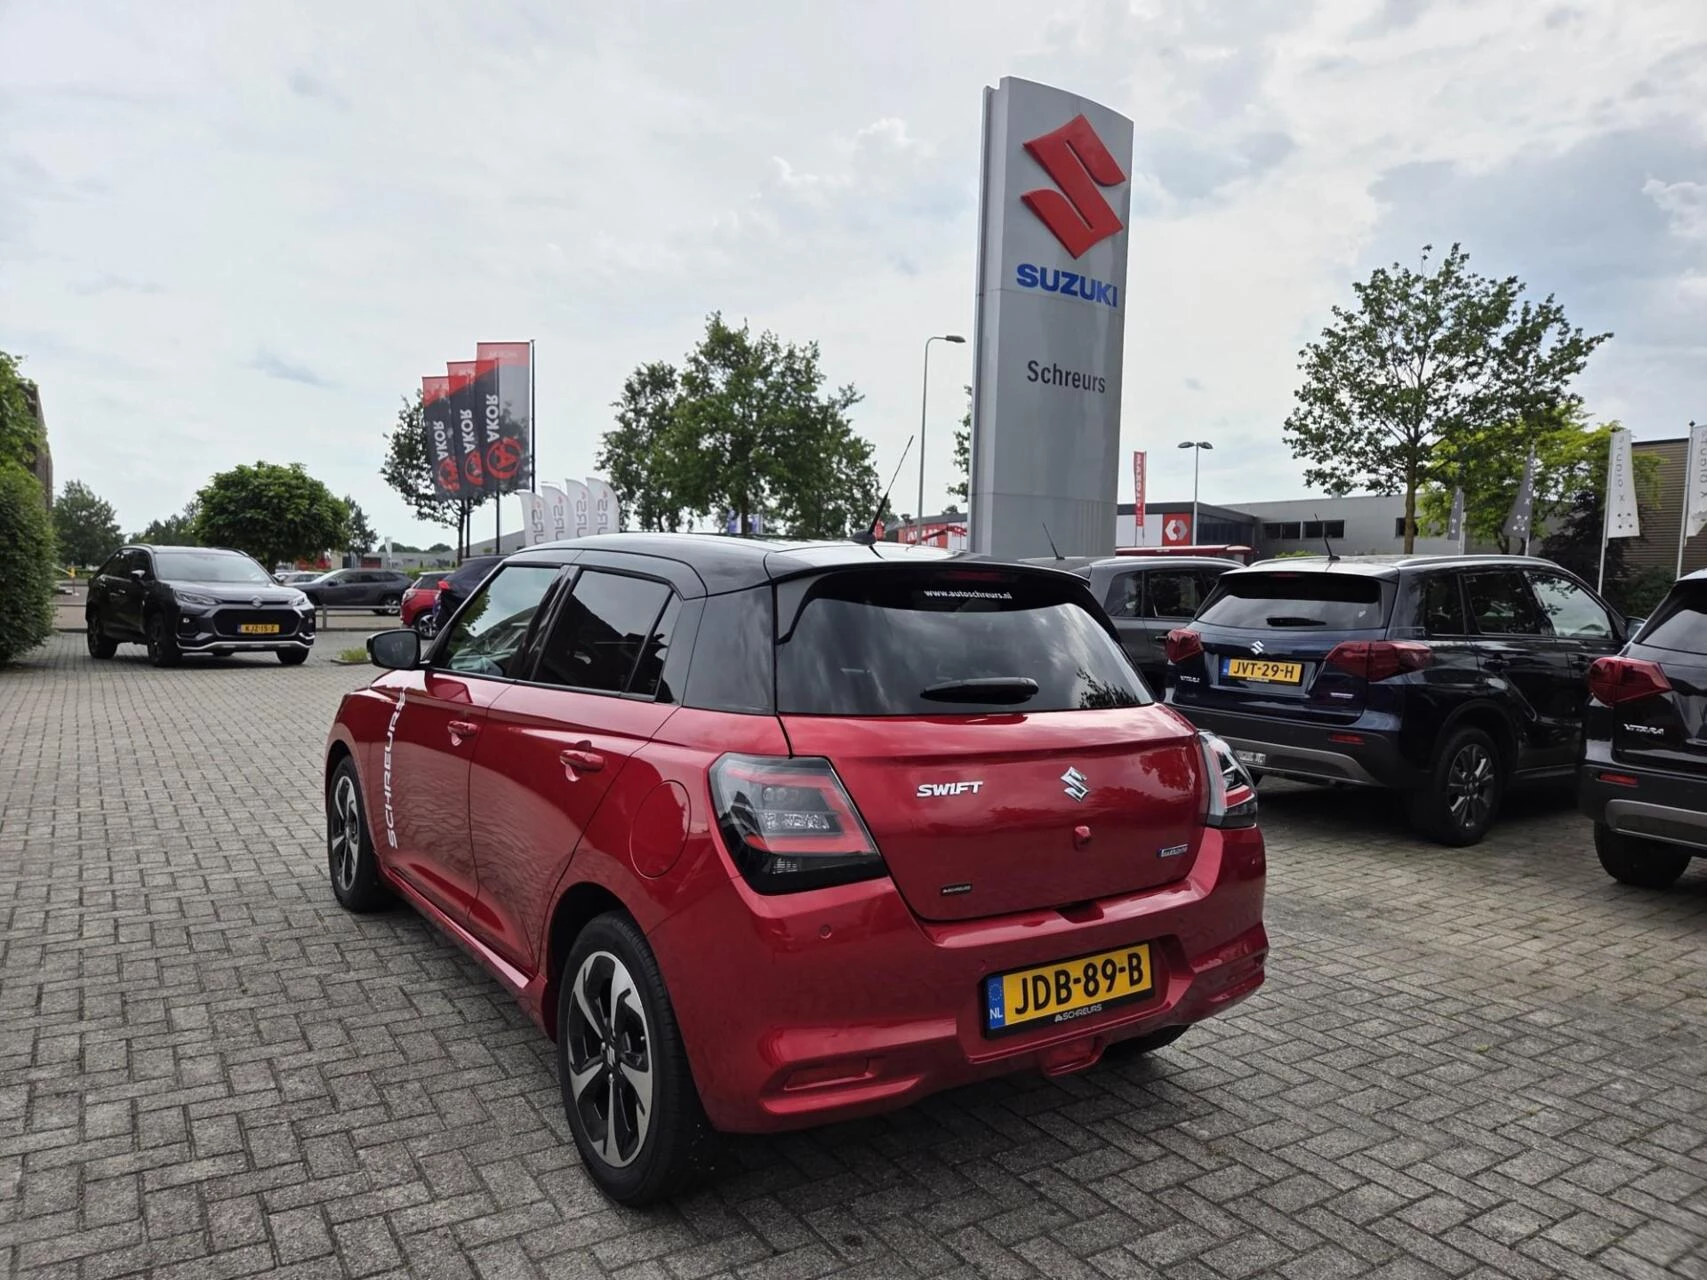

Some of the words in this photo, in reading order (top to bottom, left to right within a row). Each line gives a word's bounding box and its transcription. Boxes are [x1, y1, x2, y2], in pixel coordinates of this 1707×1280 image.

[1016, 263, 1118, 308] SUZUKI
[1026, 359, 1106, 393] Schreurs
[1233, 661, 1295, 679] JVT-29-H
[383, 689, 406, 849] SCHREURS
[916, 780, 984, 797] SWIFT
[1015, 952, 1143, 1015] JDB-89-B
[989, 1007, 1004, 1020] NL
[1061, 1003, 1103, 1021] SCHREURS
